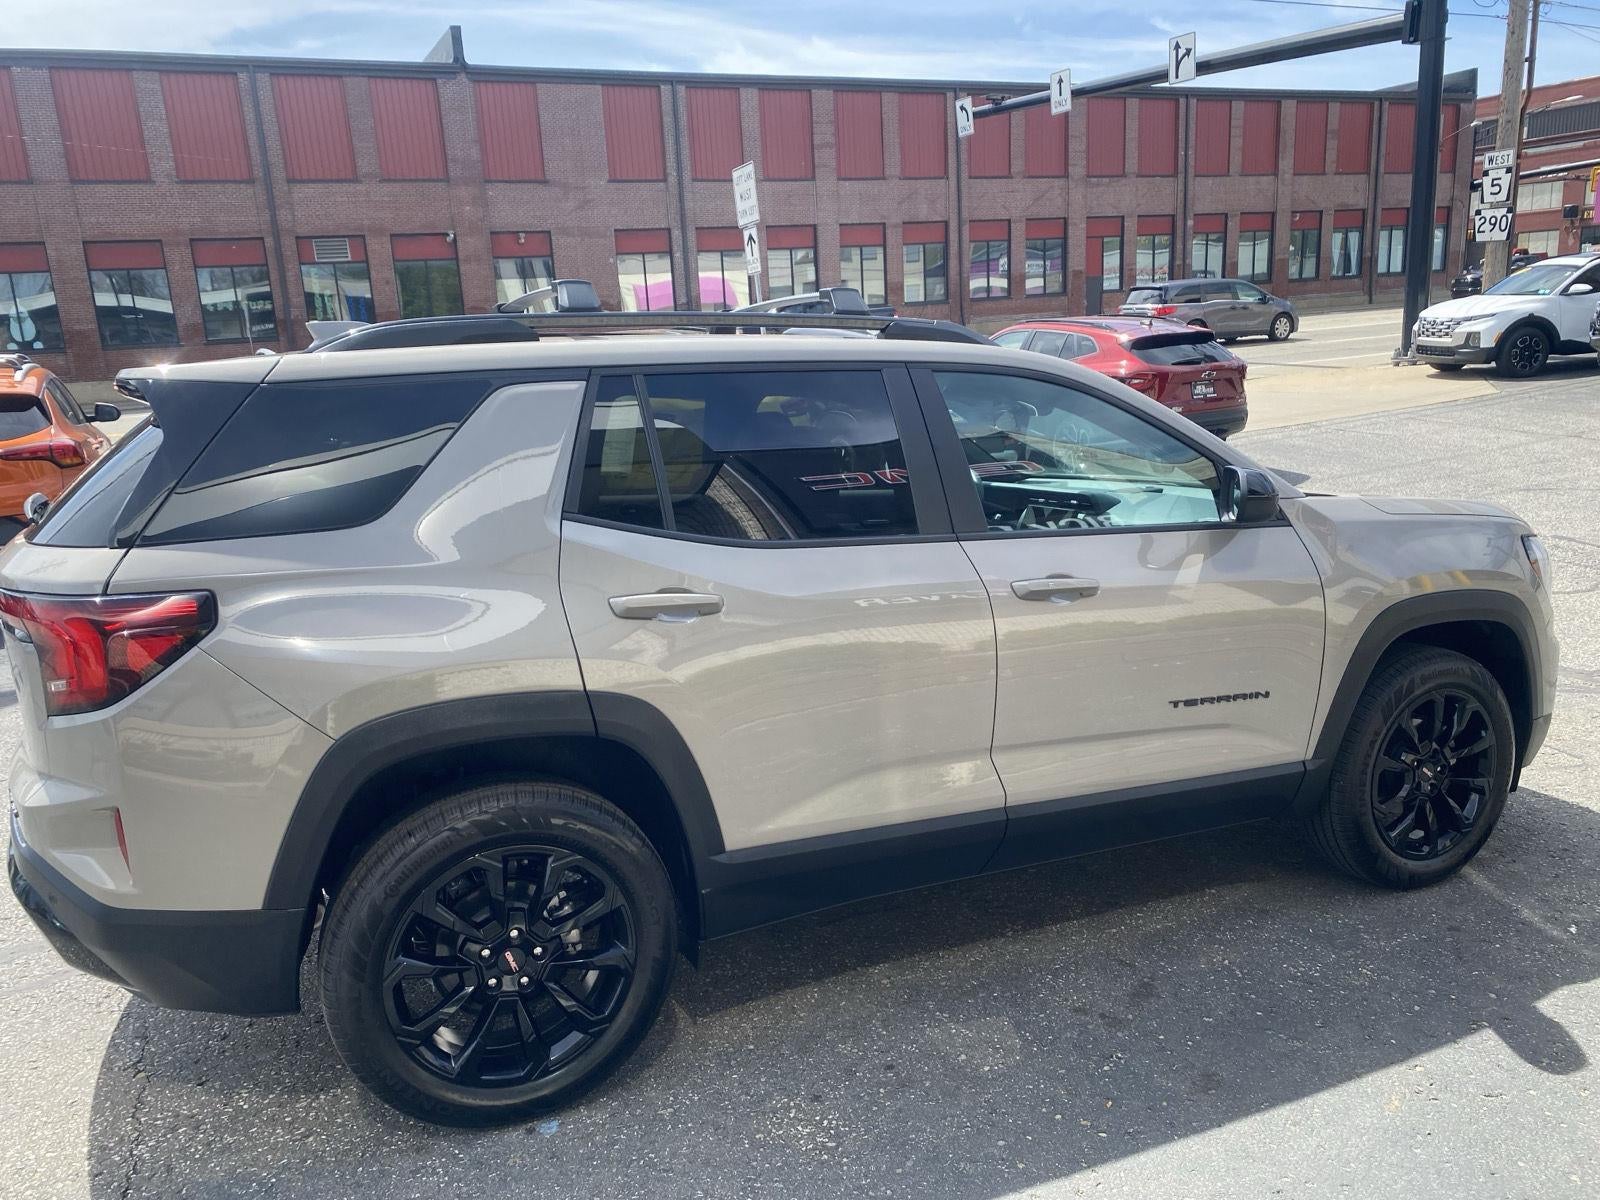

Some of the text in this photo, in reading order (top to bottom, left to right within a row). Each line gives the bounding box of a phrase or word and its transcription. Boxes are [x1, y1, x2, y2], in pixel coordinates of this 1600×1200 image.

[1054, 99, 1068, 110] ONLY
[960, 122, 972, 133] ONLY
[1487, 153, 1511, 167] WEST
[1489, 177, 1502, 196] 5
[1476, 214, 1509, 234] 290
[1168, 690, 1270, 708] TERRAIN
